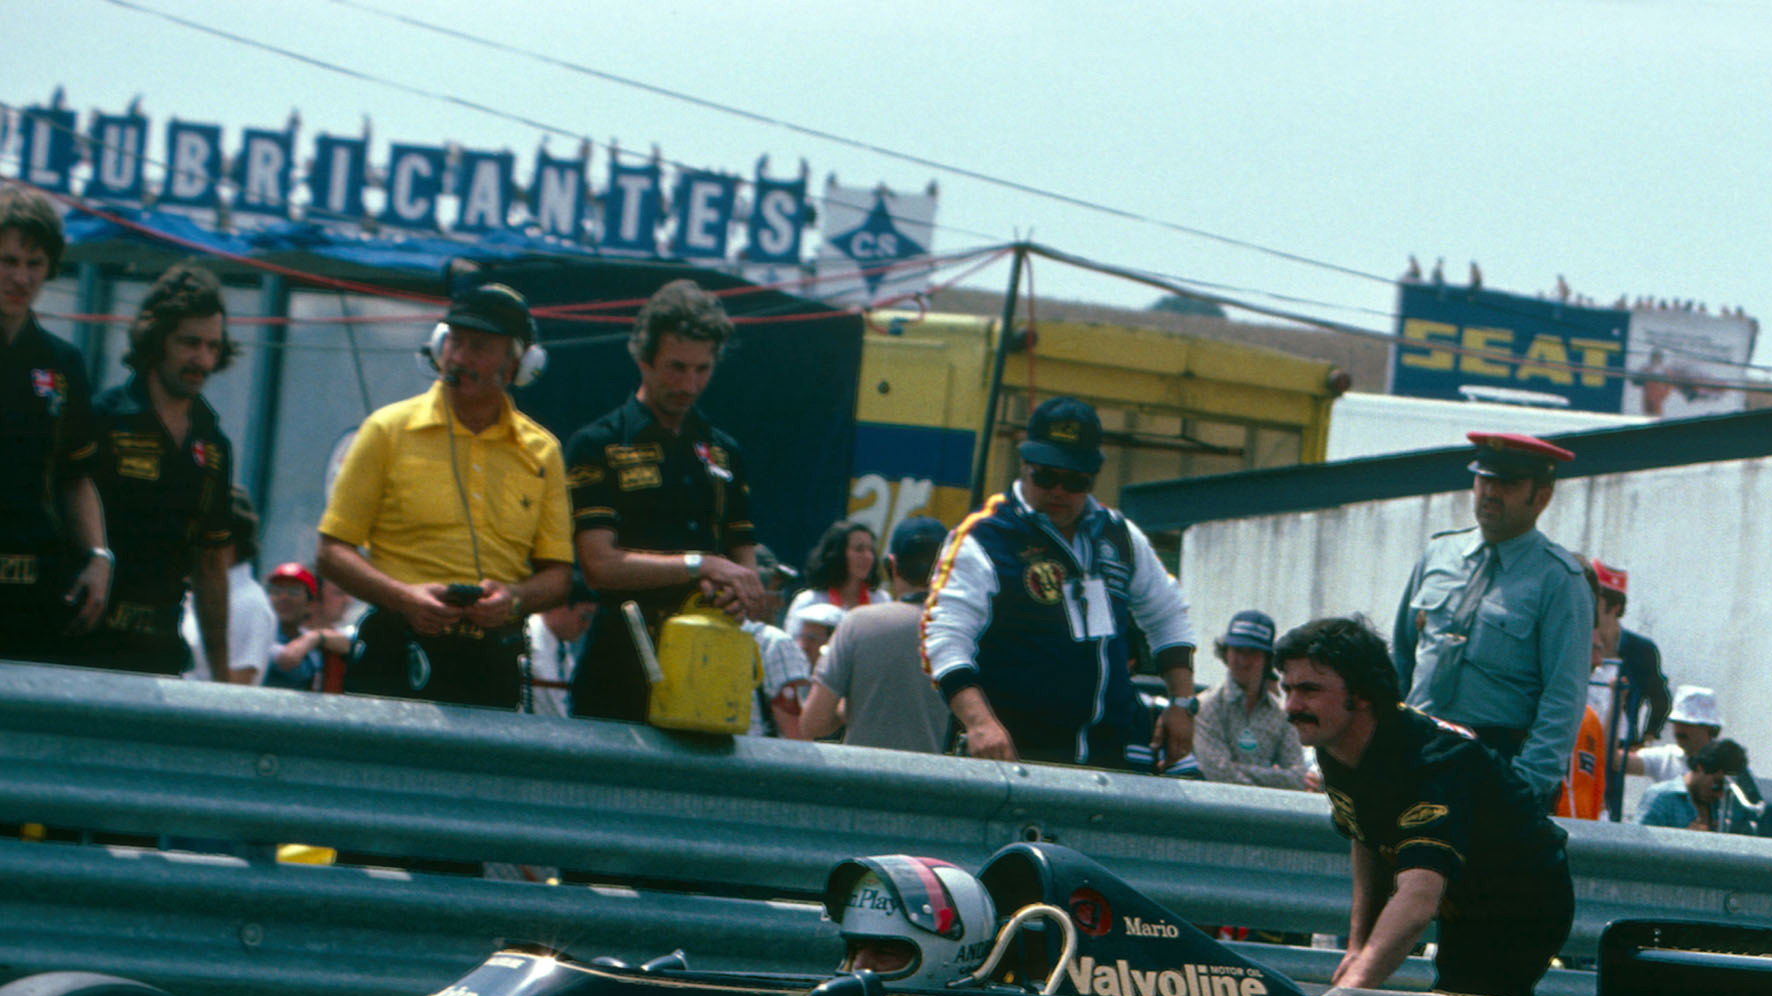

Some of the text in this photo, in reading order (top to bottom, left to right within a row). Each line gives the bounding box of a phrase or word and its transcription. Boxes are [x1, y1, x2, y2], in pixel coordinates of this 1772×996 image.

[29, 118, 798, 255] LUBRICANTES
[850, 230, 897, 258] CS
[1401, 317, 1621, 387] SEAT
[1123, 916, 1179, 938] Mario
[1209, 966, 1243, 976] MOTOR
